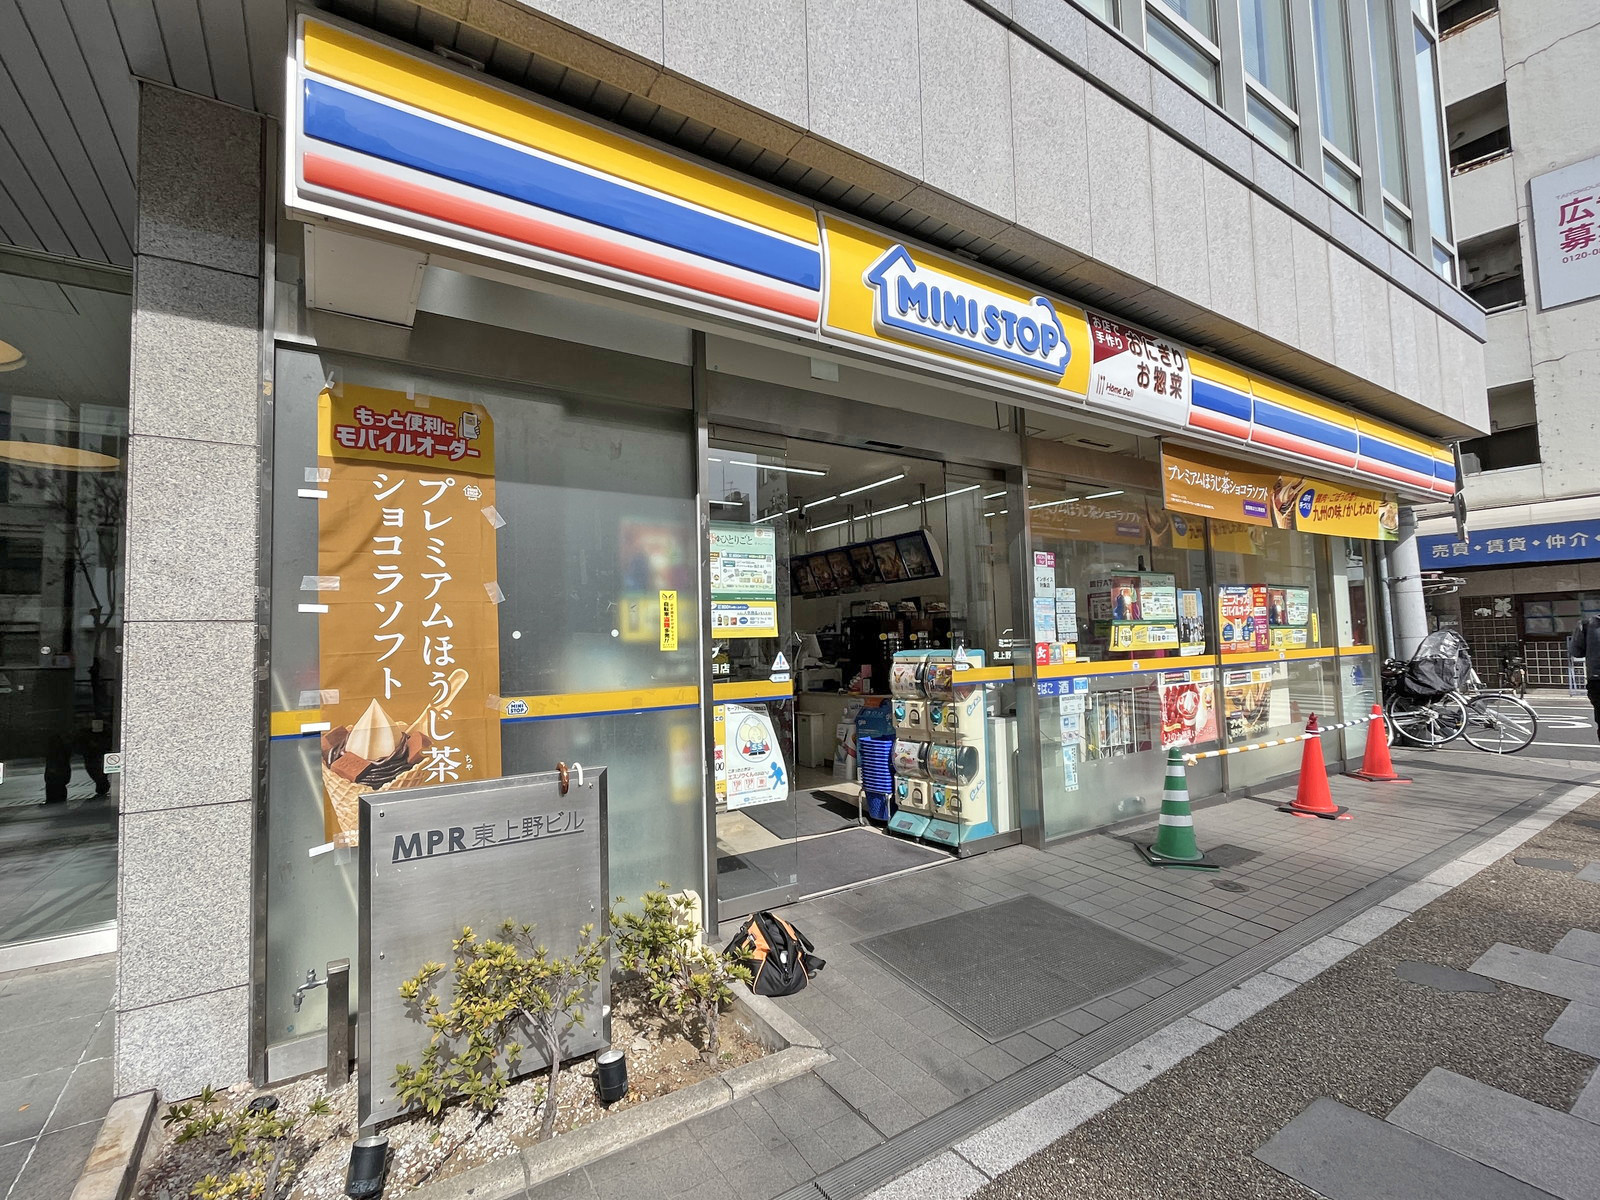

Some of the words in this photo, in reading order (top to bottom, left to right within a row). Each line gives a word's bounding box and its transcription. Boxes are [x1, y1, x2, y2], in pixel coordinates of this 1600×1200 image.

[1559, 195, 1600, 226] 広
[1560, 222, 1600, 253] 募
[1562, 248, 1600, 264] 0120-0
[897, 274, 979, 335] MINI
[984, 303, 1058, 357] STOP
[1092, 316, 1121, 336] お店で
[1095, 330, 1123, 350] 手作り
[1125, 330, 1184, 373] おにぎり
[1137, 361, 1183, 400] お惣菜
[356, 407, 454, 437] もっと便利に
[336, 426, 479, 460] モバイルオーダー
[1168, 465, 1268, 502] プレミアムほうじ茶ショコラソフト
[372, 472, 406, 700] ショコラソフト
[418, 477, 462, 783] プレミアムほうじ茶
[1058, 681, 1070, 694] 酒
[392, 827, 467, 861] MPR
[471, 810, 585, 848] 東上野ビル
